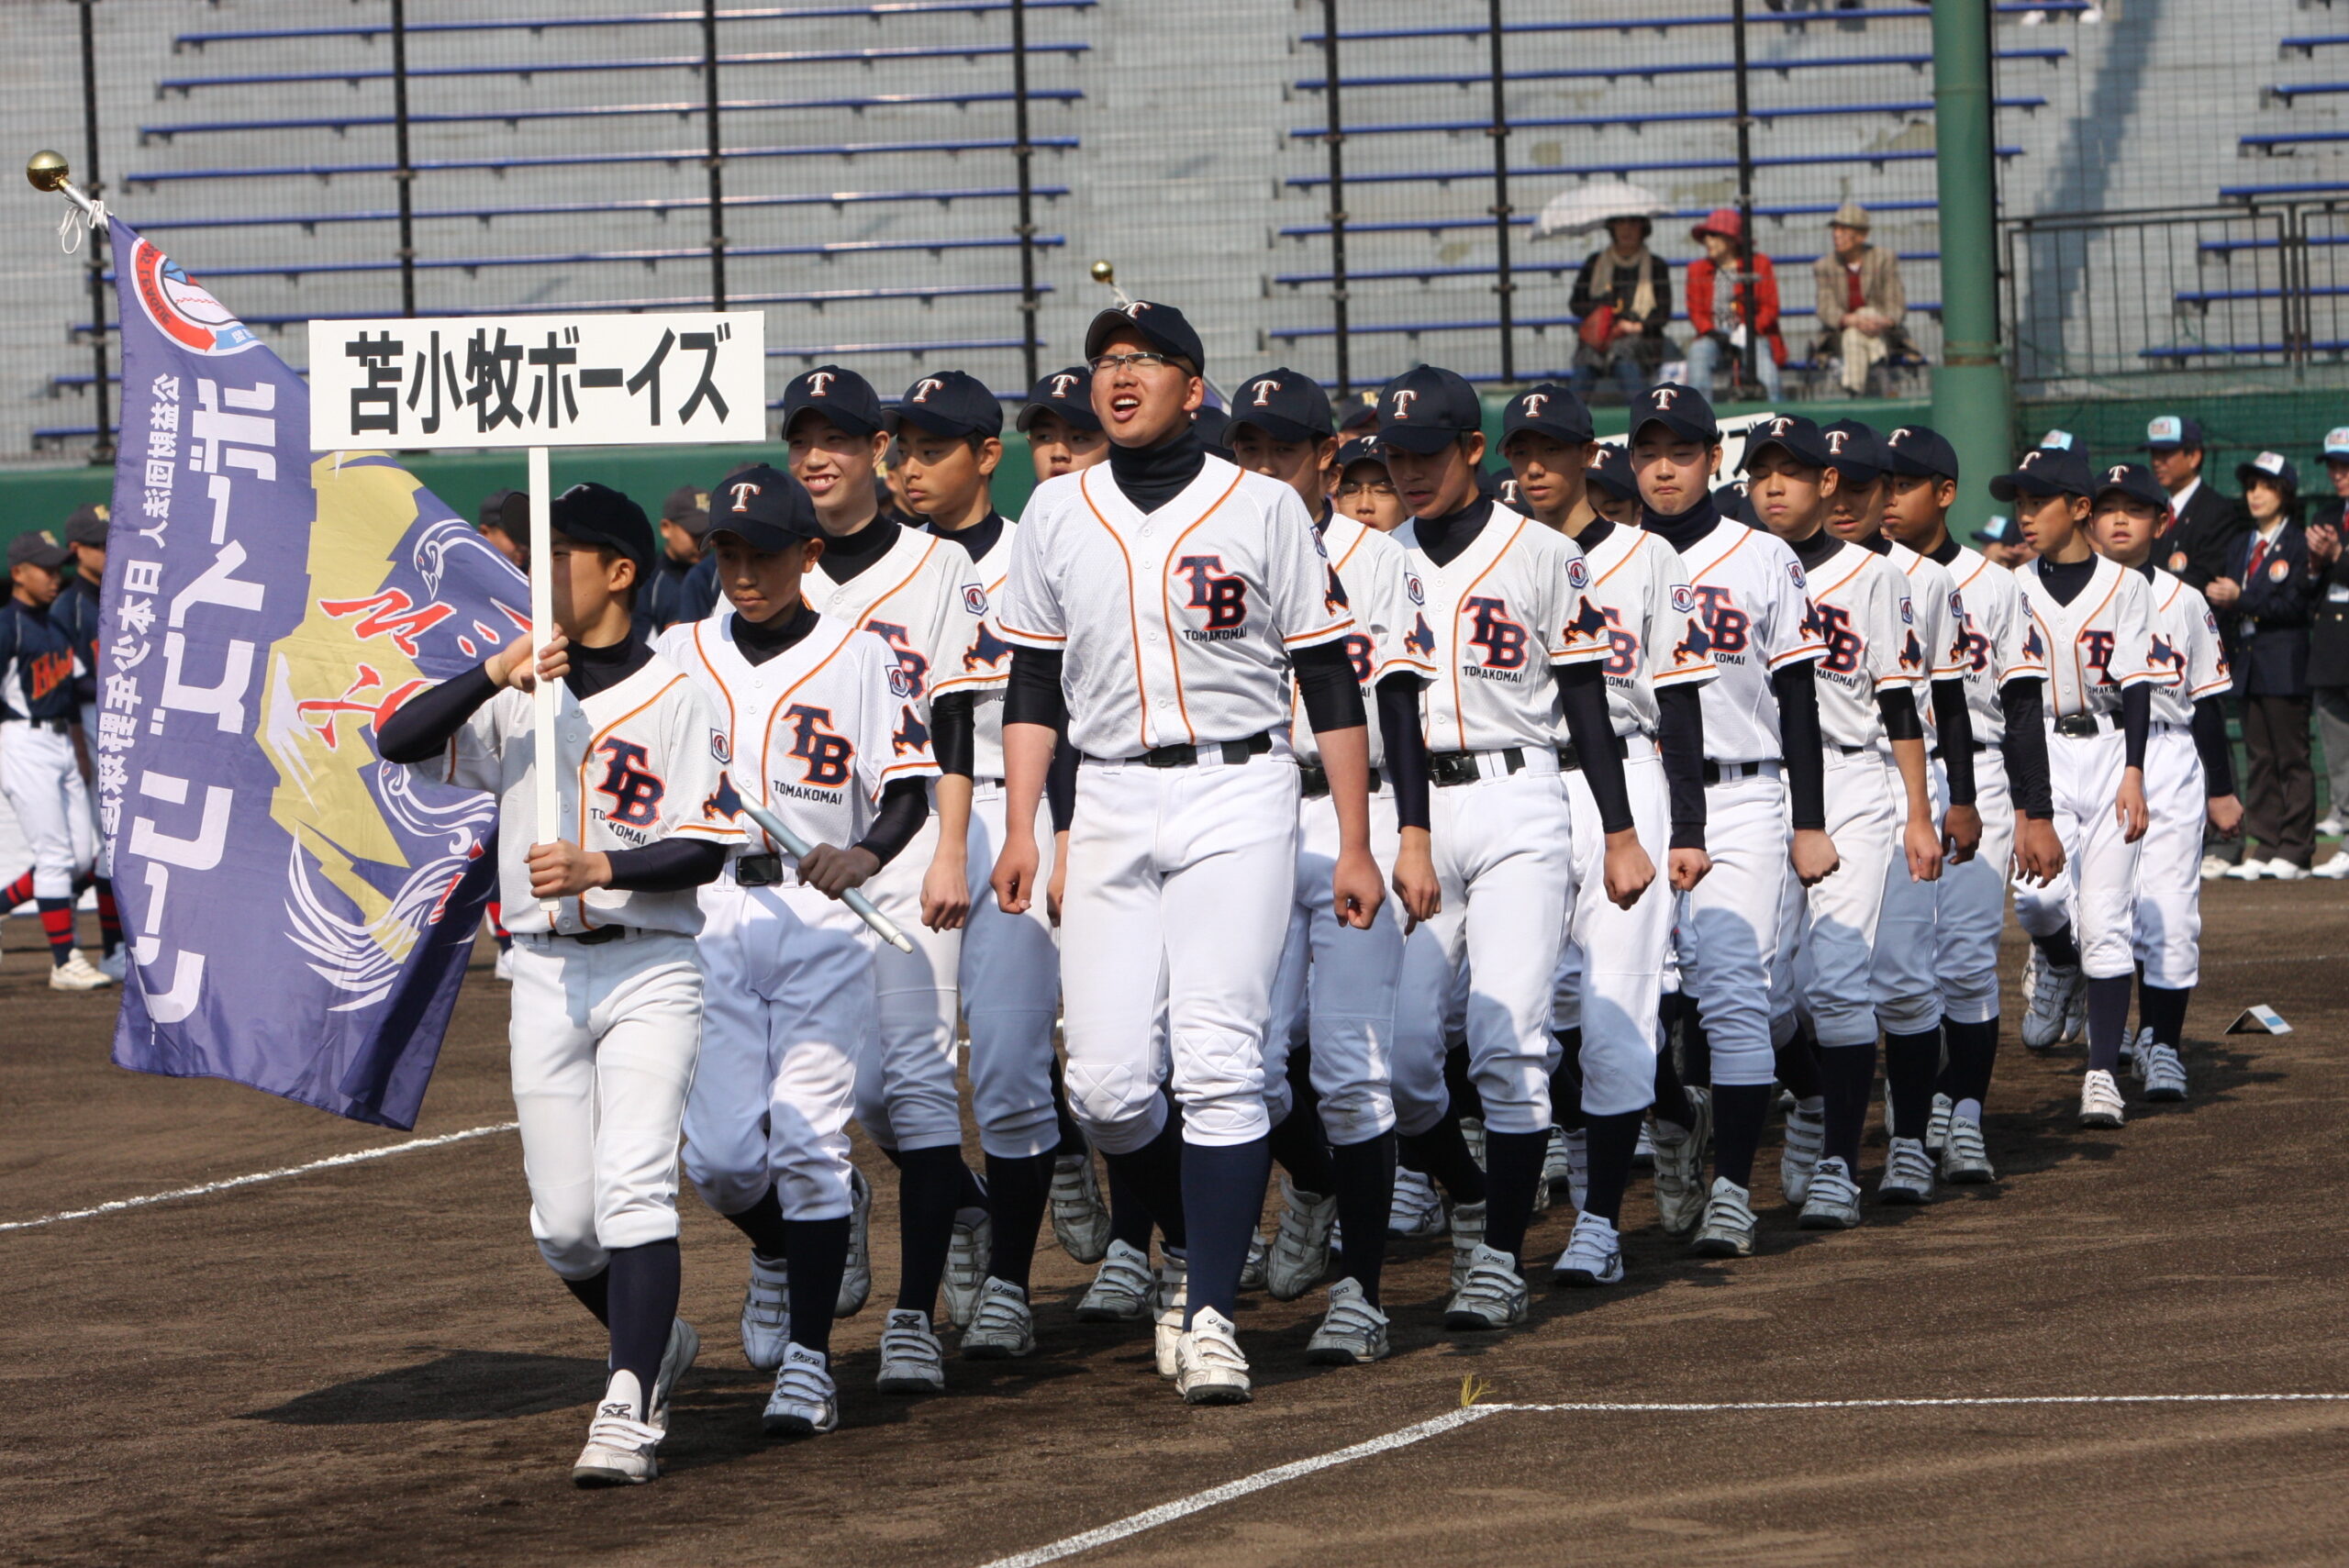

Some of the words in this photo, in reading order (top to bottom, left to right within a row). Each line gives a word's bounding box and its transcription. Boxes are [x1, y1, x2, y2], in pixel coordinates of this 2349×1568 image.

[1121, 301, 1151, 319] T
[345, 321, 731, 436] 苫小牧ボーイズ
[807, 372, 835, 396] T
[912, 378, 944, 403] T
[1051, 374, 1079, 398] T
[1252, 379, 1280, 406] T
[1392, 389, 1418, 419] T
[1652, 388, 1678, 410] T
[1522, 393, 1549, 417] T
[1769, 417, 1794, 436] T
[1887, 428, 1912, 447] T
[1825, 430, 1849, 454] T
[2109, 464, 2129, 483] T
[729, 483, 761, 512] T
[1173, 555, 1247, 631] TB
[1183, 626, 1247, 642] TOMAKOMAI
[1461, 595, 1531, 670] TB
[1714, 652, 1745, 665] KOMAI
[1463, 666, 1522, 684] TOMAKOMAI
[1604, 675, 1634, 689] KOMAI
[1814, 668, 1858, 688] MAKOMAI
[781, 703, 856, 788] TB
[595, 735, 666, 828] TB
[773, 780, 842, 805] TOMAKOMAI
[590, 807, 646, 845] TOKOMAI
